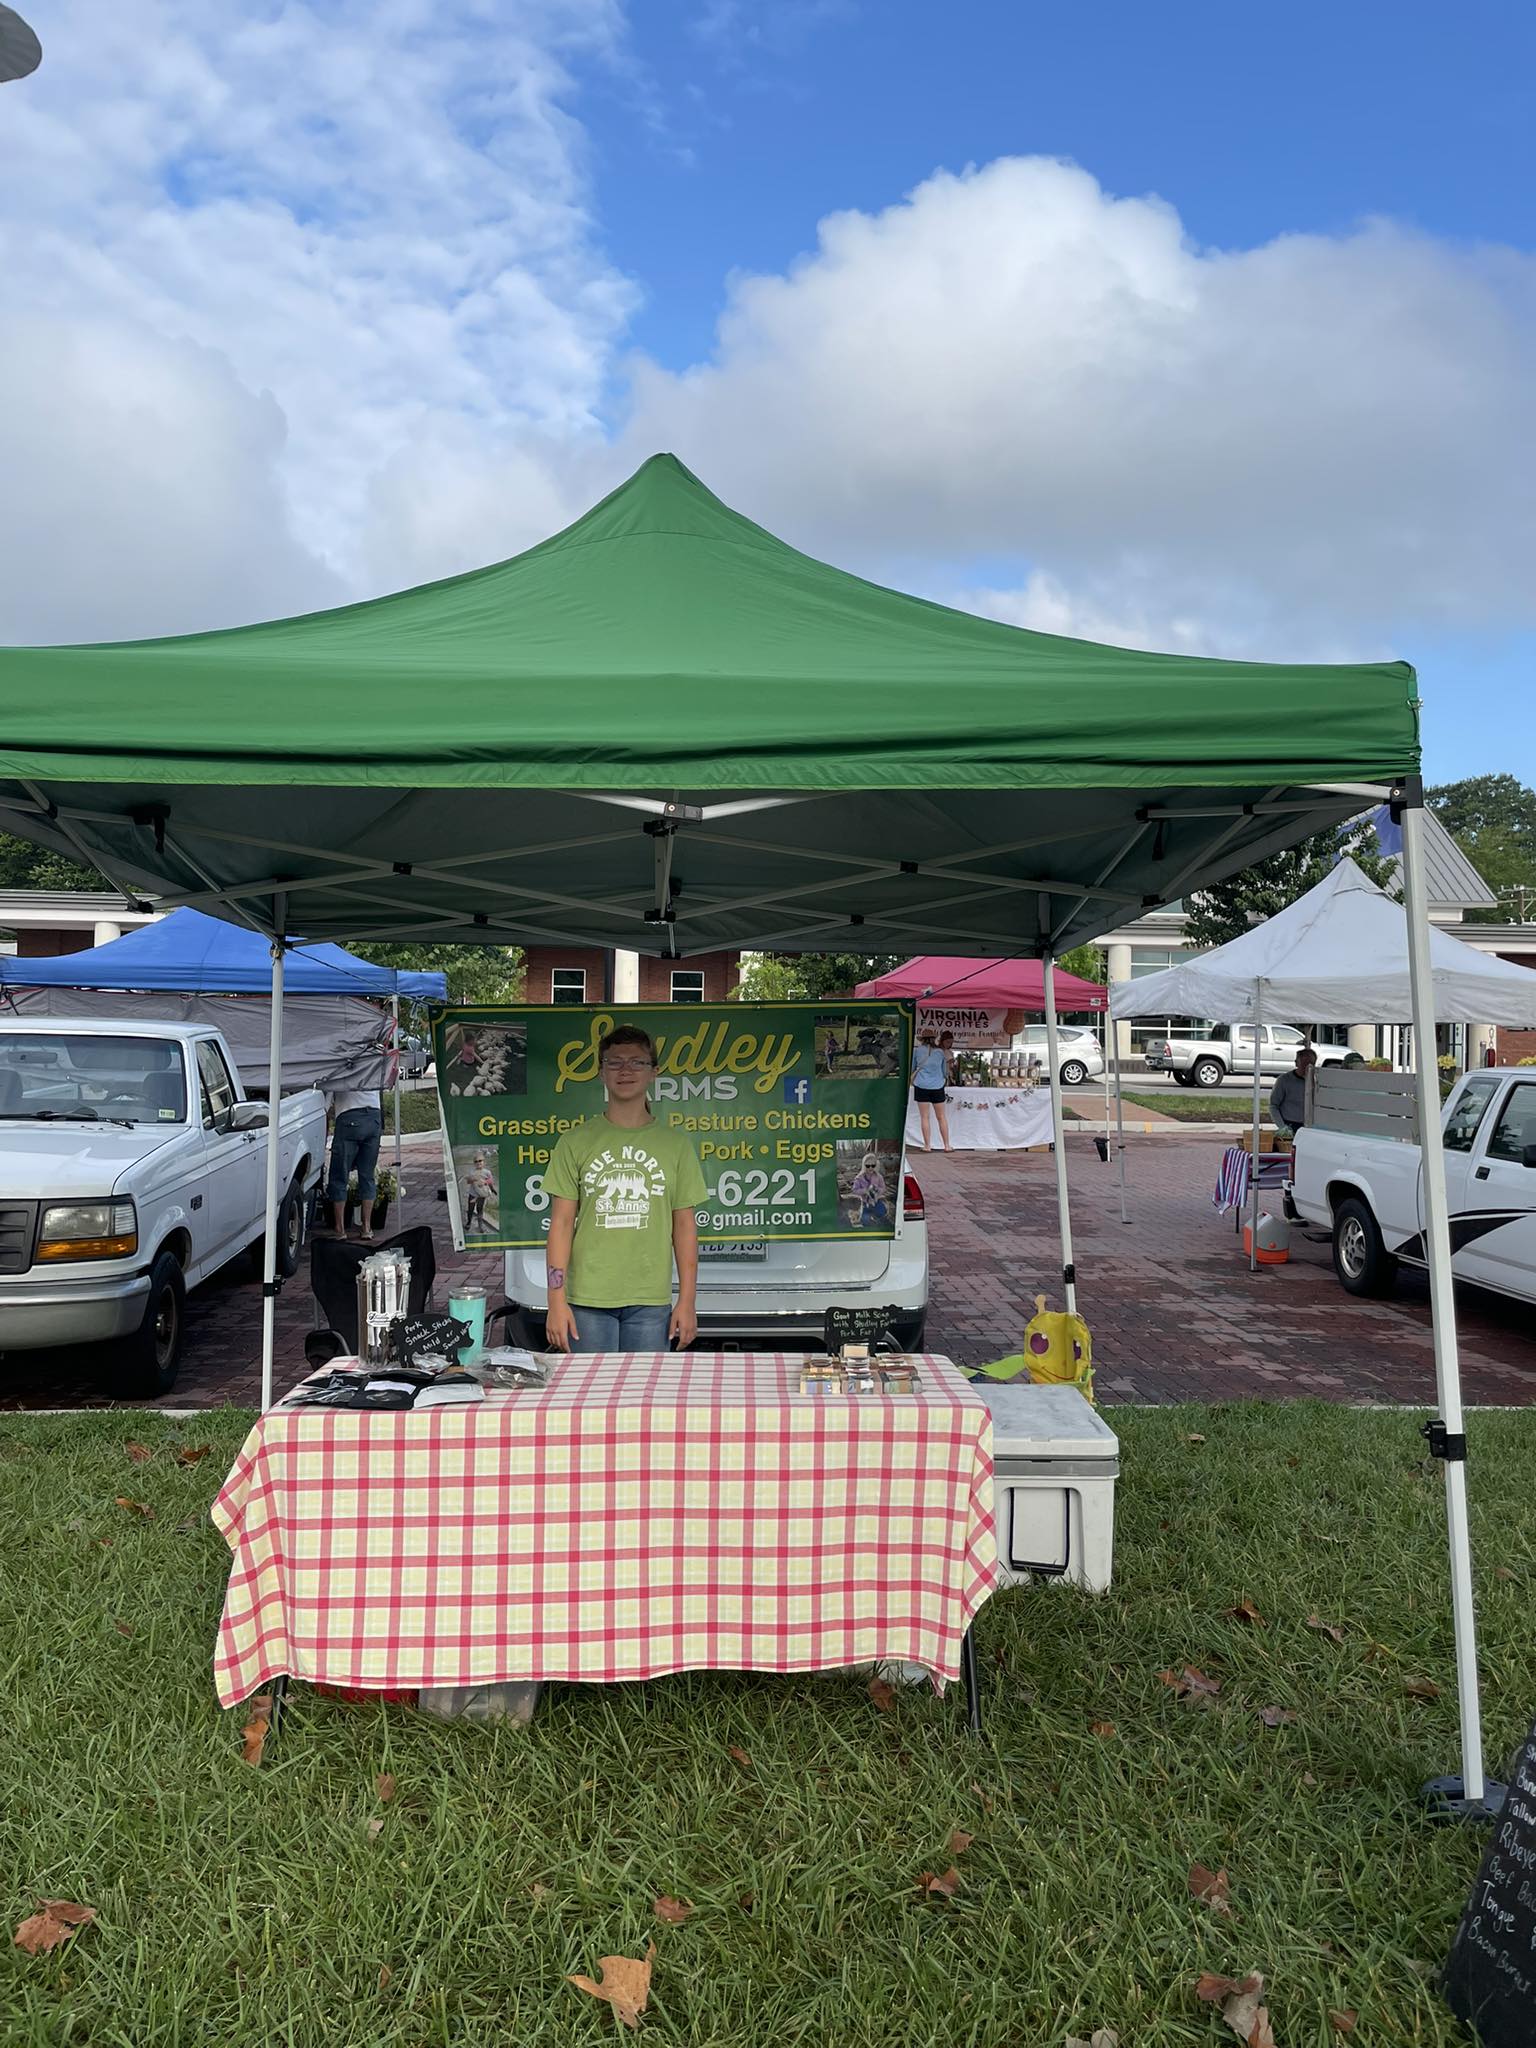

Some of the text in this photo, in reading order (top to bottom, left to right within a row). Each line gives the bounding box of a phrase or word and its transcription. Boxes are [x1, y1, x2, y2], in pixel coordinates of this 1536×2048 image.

[919, 1009, 989, 1021] VIRGINIA
[920, 1020, 989, 1029] FAVORITES
[555, 1014, 801, 1093] Sdley
[603, 1076, 739, 1103] RMS
[668, 1109, 871, 1132] Pasture Chickens
[701, 1138, 835, 1164] Pork Eggs
[584, 1145, 666, 1197] TRUE NORTH
[615, 1198, 650, 1214] Ann's
[404, 1320, 423, 1335] Pork
[405, 1328, 431, 1346] Snack
[1489, 1855, 1515, 1889] Beef
[1481, 1879, 1515, 1933] Tongue
